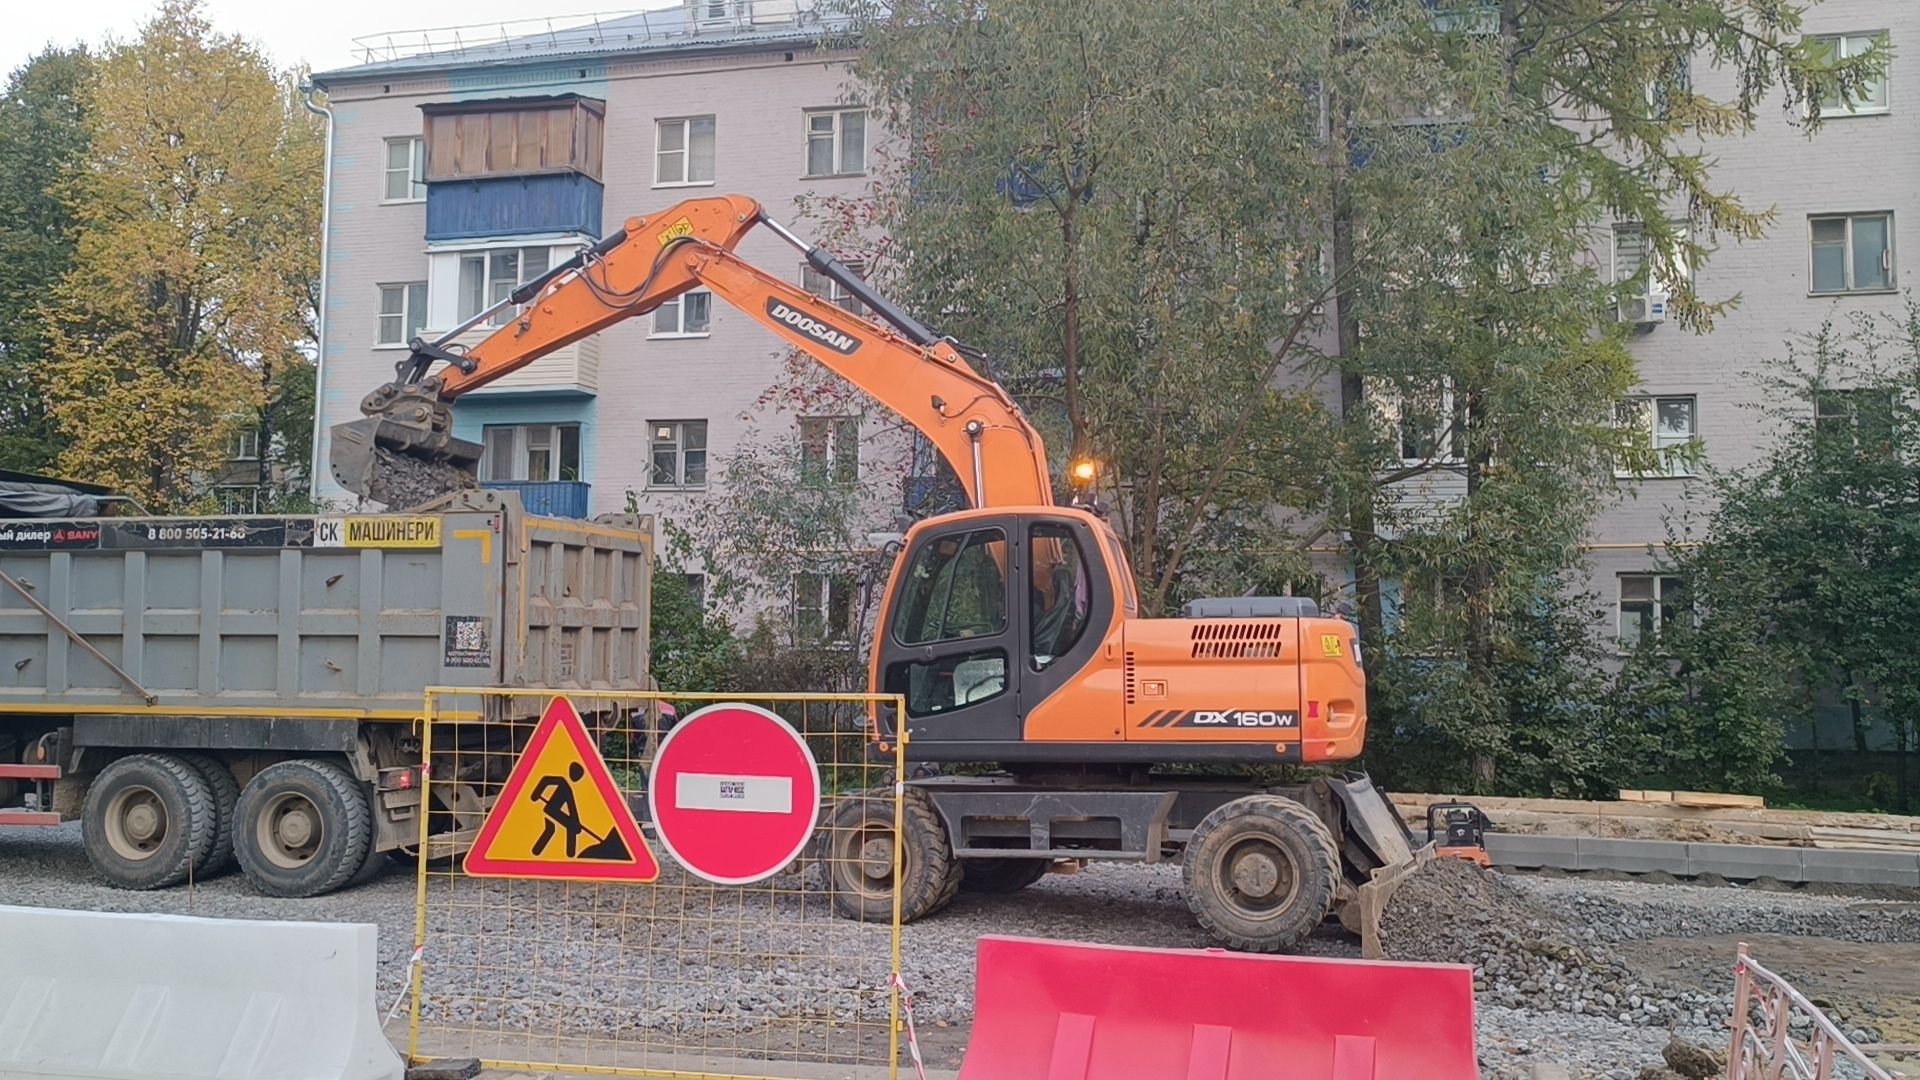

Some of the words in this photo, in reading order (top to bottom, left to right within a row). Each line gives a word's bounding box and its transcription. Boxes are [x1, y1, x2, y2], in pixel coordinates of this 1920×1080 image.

[771, 304, 854, 350] DOOSAN
[16, 531, 51, 543] дилер
[67, 530, 98, 540] SANY
[148, 528, 156, 539] 8
[159, 528, 182, 539] 800
[320, 522, 339, 541] СК
[349, 521, 434, 541] МАШИНЕРИ
